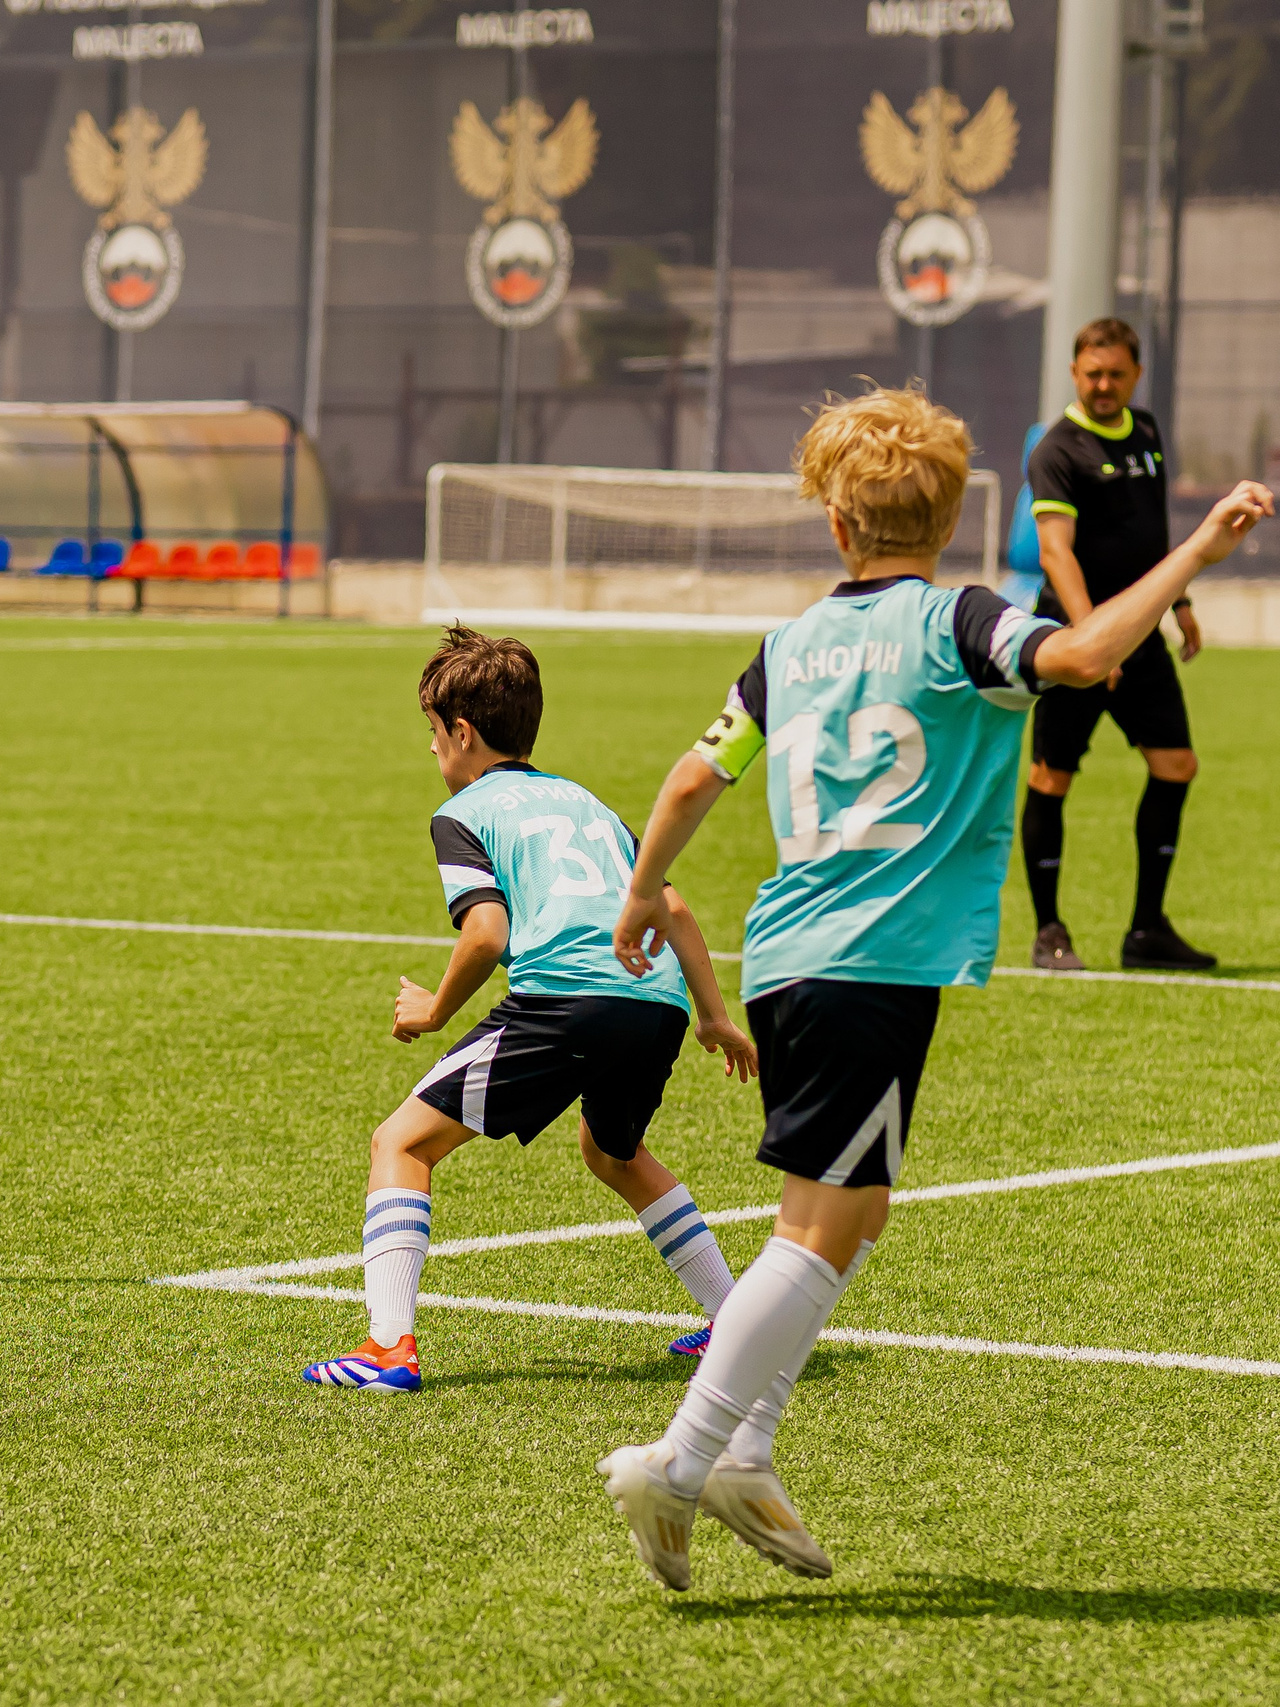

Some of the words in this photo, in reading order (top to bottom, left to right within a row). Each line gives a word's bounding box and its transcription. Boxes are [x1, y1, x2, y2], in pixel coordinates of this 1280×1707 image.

[455, 8, 595, 48] МАЦЕСТА
[866, 0, 1015, 39] МАЦЕСТА
[72, 21, 205, 61] МАЦЕСТА
[769, 702, 927, 864] 12
[519, 814, 634, 902] 31
